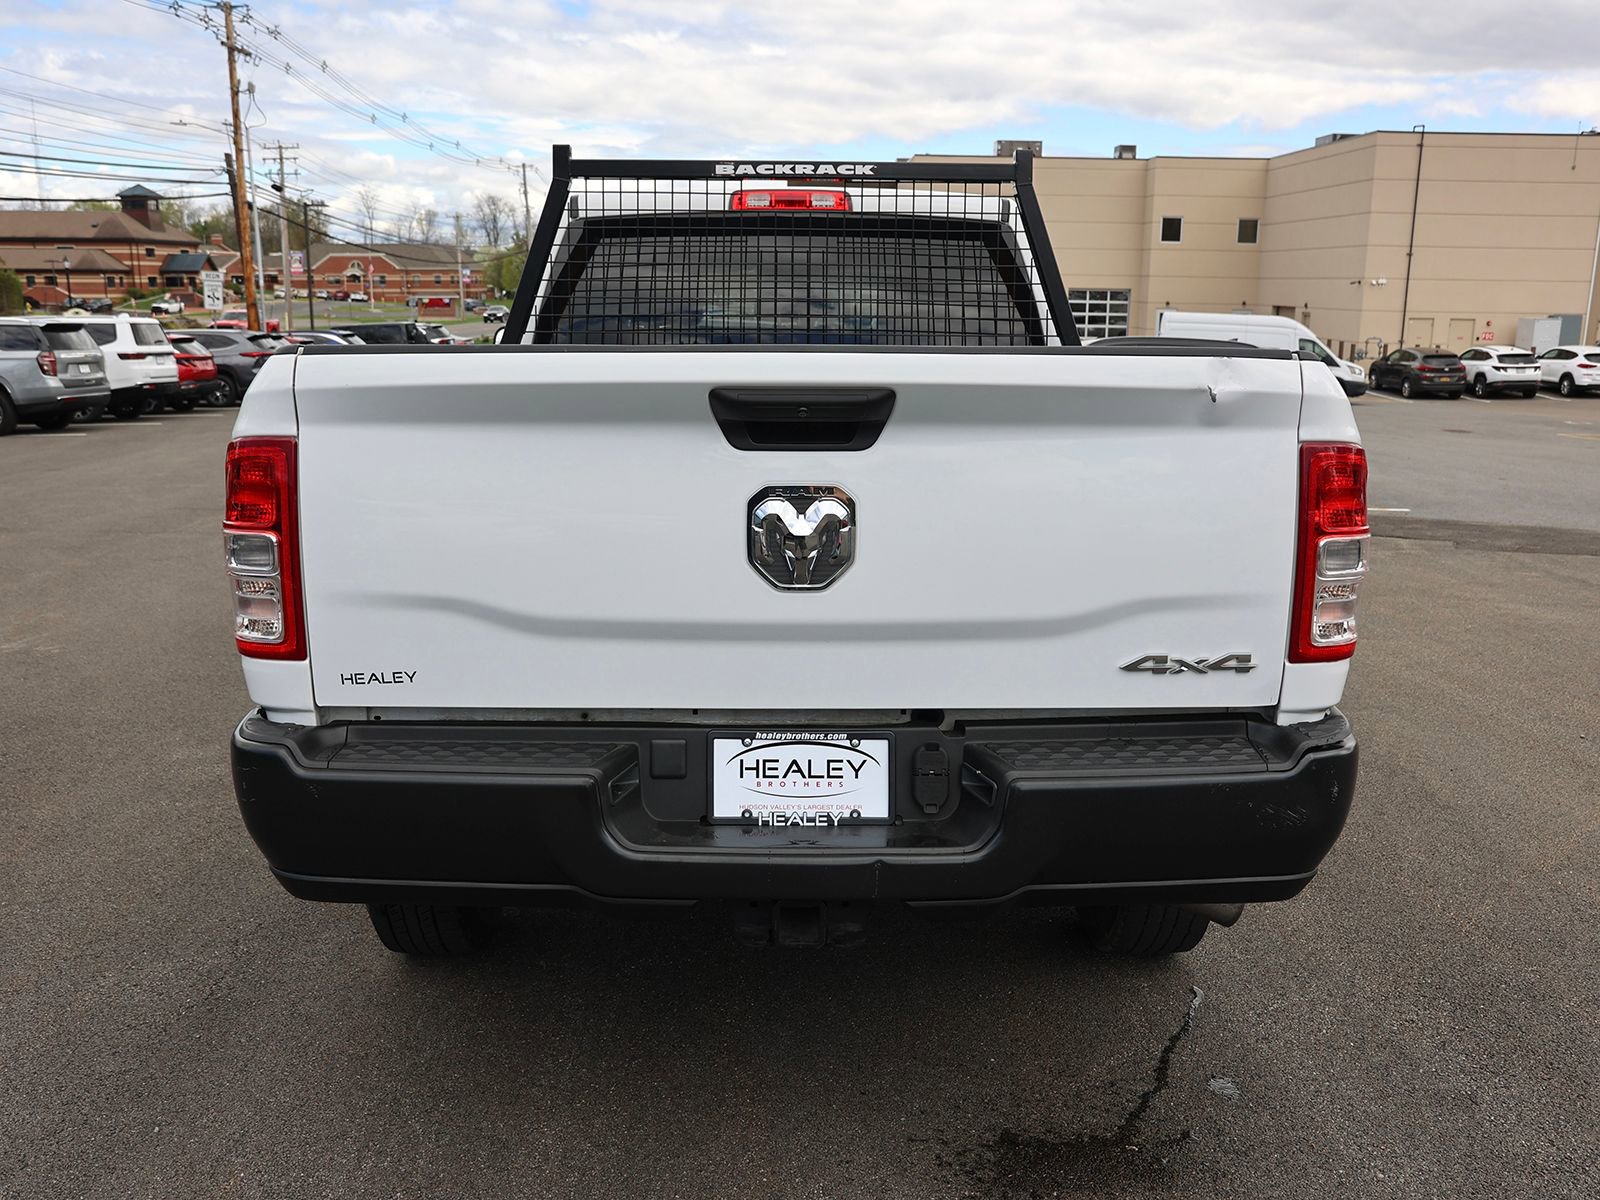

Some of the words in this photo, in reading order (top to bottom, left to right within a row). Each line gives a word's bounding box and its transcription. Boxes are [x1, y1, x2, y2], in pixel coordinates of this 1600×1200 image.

[715, 164, 875, 175] BACKRACK
[768, 486, 835, 497] RAM
[340, 671, 417, 685] HEALEY
[755, 732, 848, 741] healeybrothers.com
[739, 759, 867, 779] HEALEY
[758, 811, 844, 826] HEALEY
